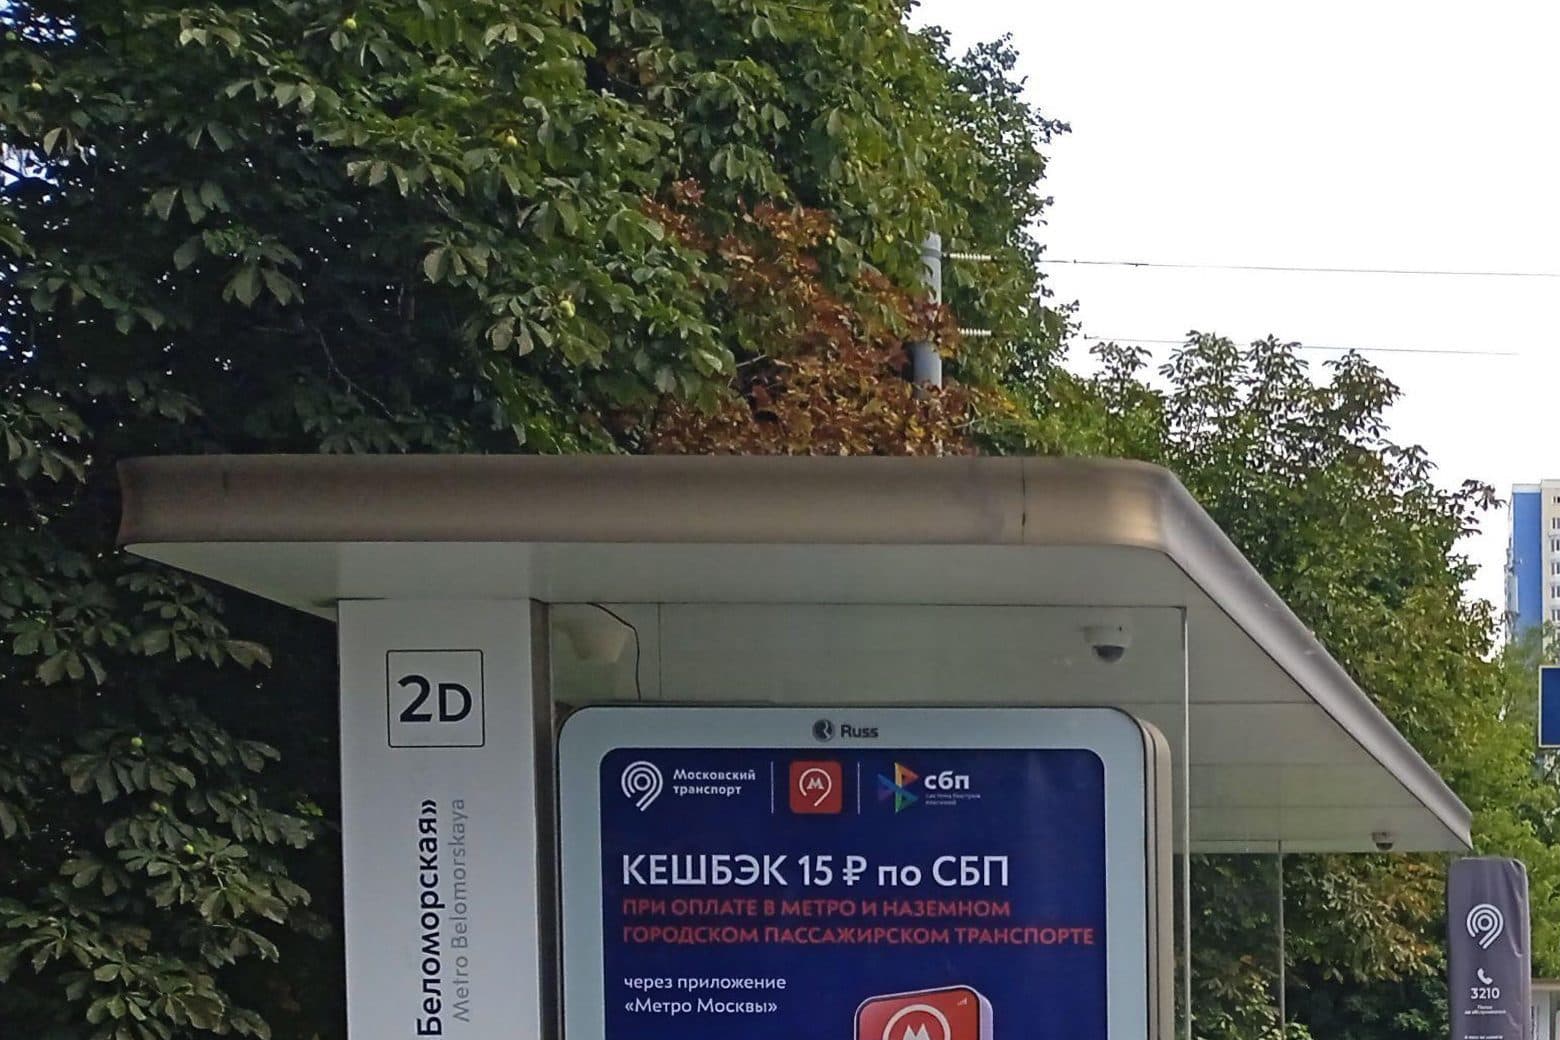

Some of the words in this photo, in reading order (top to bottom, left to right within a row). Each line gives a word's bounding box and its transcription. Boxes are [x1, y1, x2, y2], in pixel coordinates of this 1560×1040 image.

[397, 675, 472, 723] 2D
[840, 724, 879, 739] Russ
[673, 768, 756, 782] Московский
[924, 772, 970, 791] сбп
[673, 784, 742, 797] транспорт
[450, 798, 468, 949] Belomorskaya
[622, 854, 788, 886] КЕШБЭК
[798, 855, 833, 886] 15
[878, 866, 922, 886] по
[932, 855, 1009, 886] СБП
[622, 900, 664, 917] ПРИ
[671, 899, 758, 918] ОПЛАТЕ
[764, 900, 775, 916] В
[781, 898, 856, 917] МЕТРО
[863, 900, 877, 917] И
[883, 900, 1011, 917] НАЗЕМНОМ
[622, 926, 758, 945] ГОРОДСКОМ
[764, 926, 950, 944] ПАССАЖИРСКОМ
[956, 928, 1094, 946] ТРАНСПОРТЕ
[452, 953, 470, 1022] Metro
[624, 977, 673, 992] через
[678, 975, 786, 992] приложение
[1470, 987, 1500, 999] 3210
[624, 999, 692, 1016] «Метро
[698, 999, 778, 1015] Москвы»
